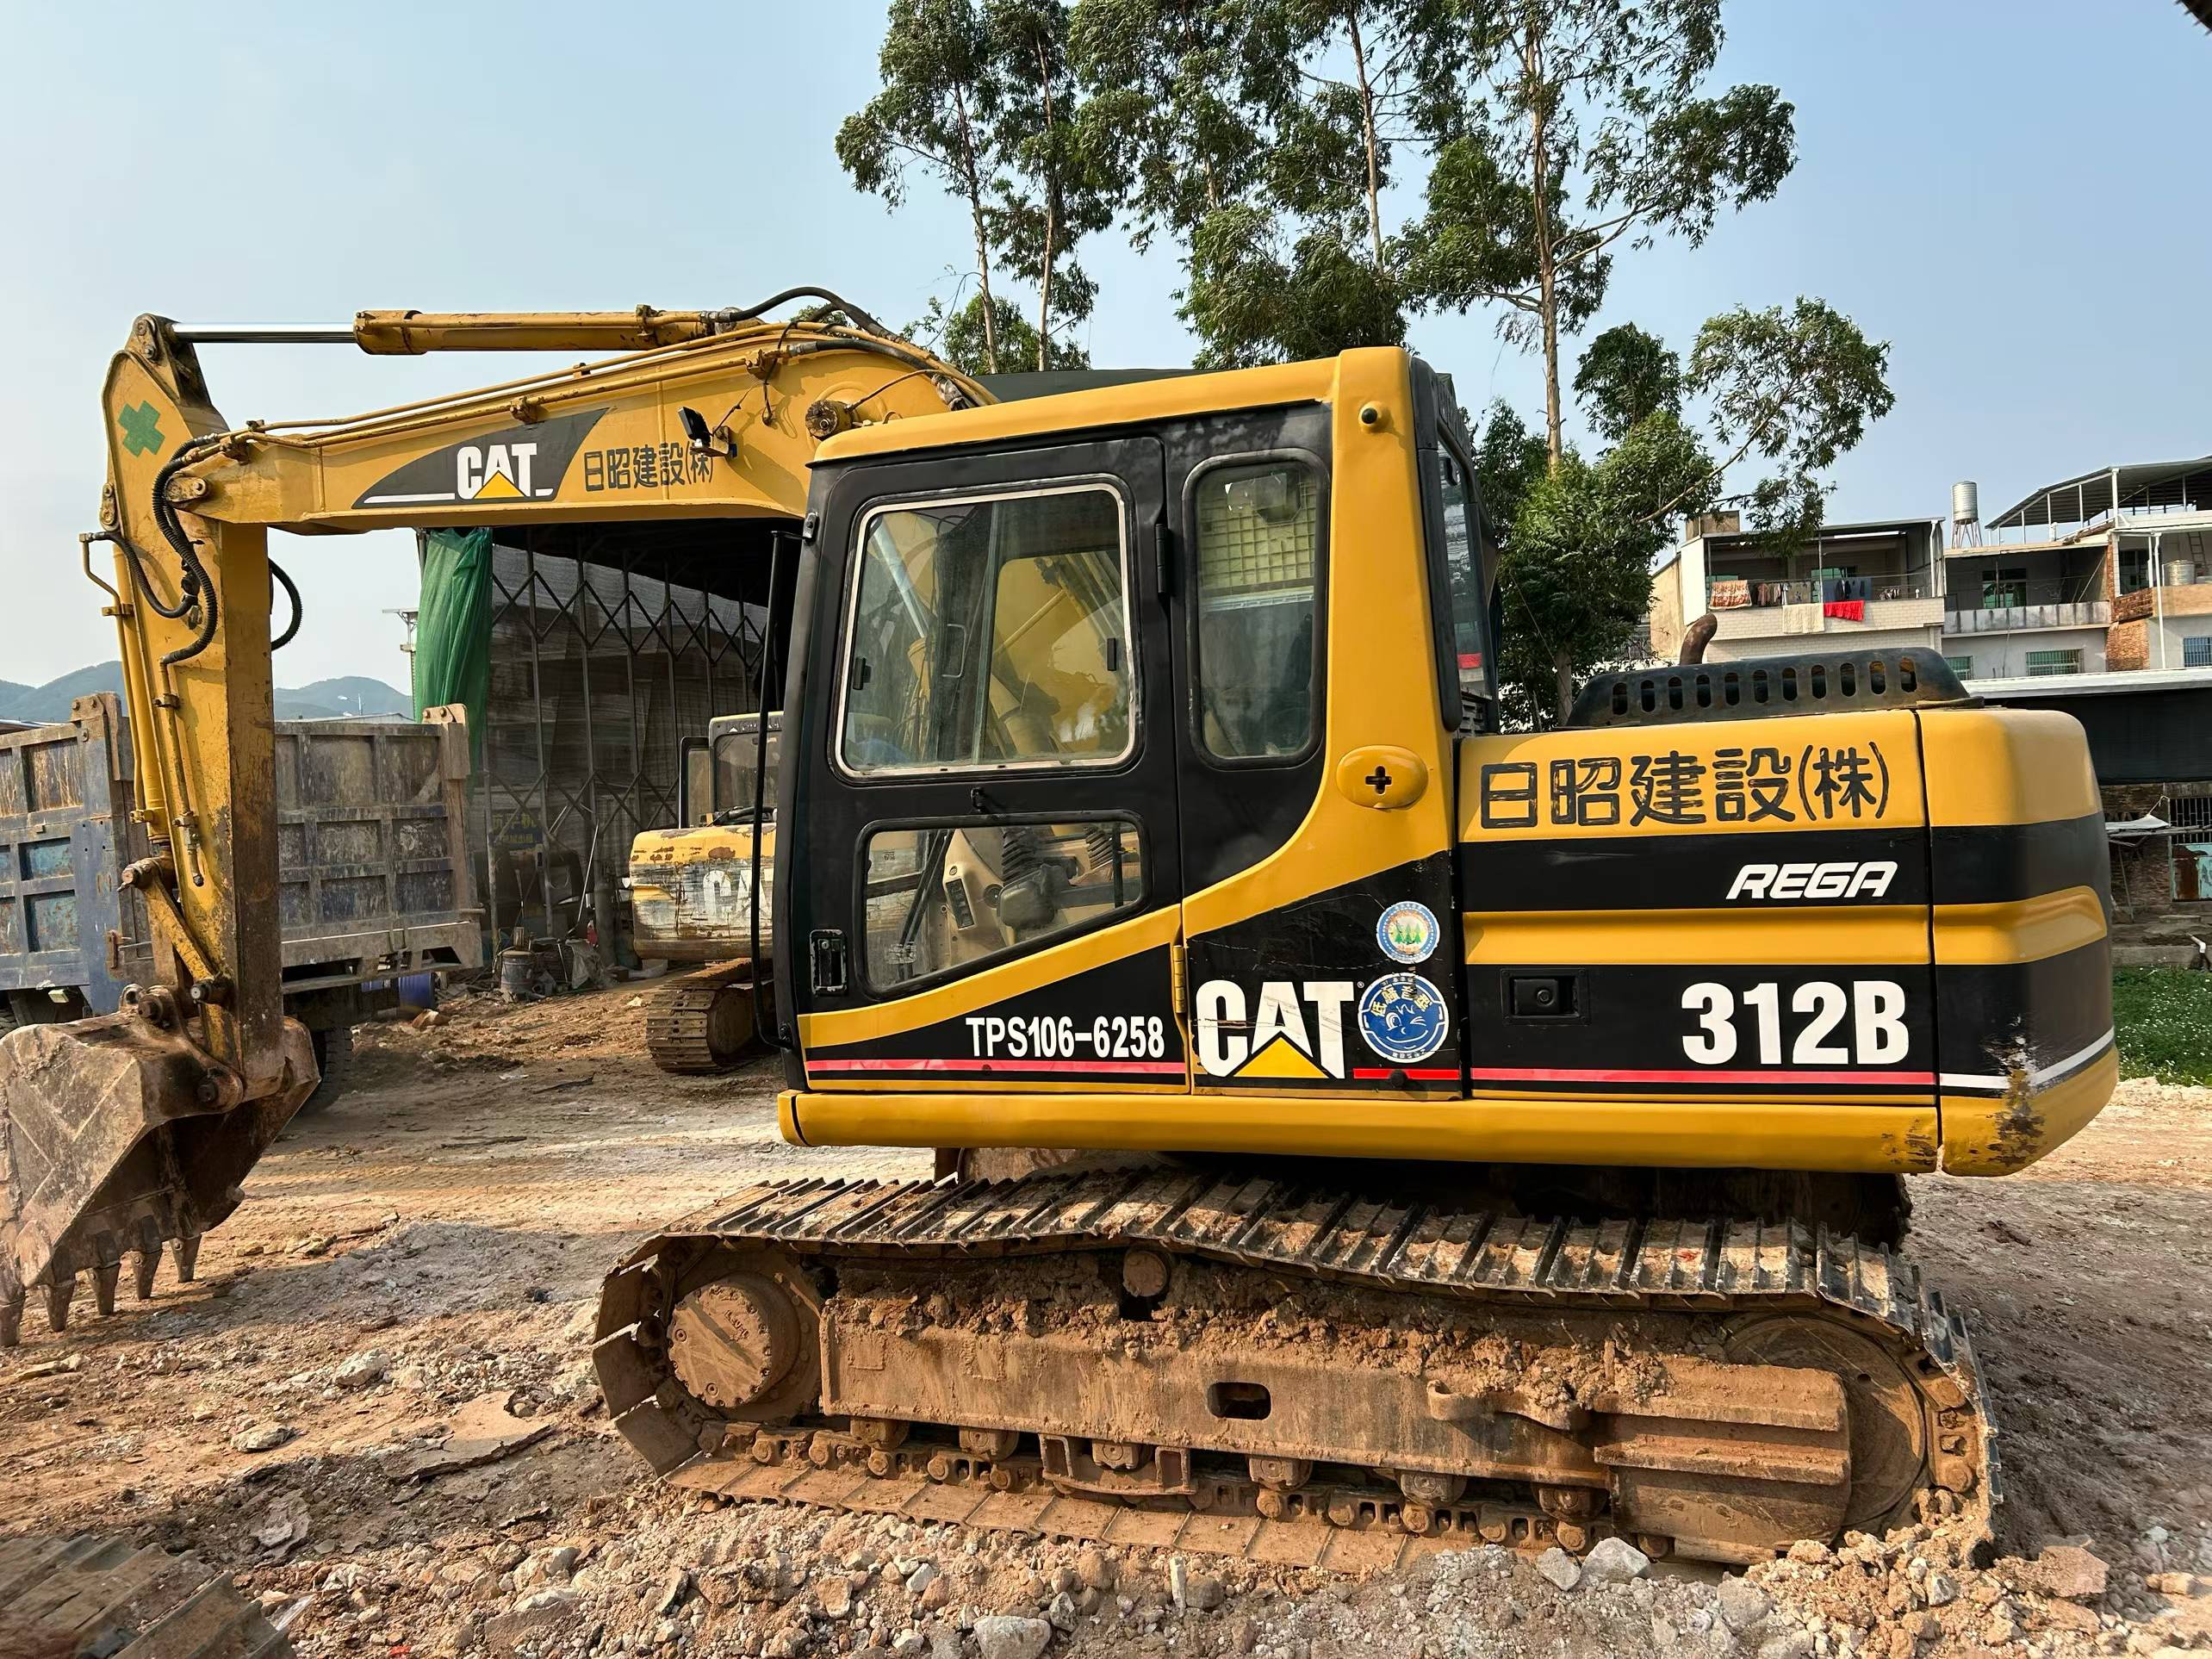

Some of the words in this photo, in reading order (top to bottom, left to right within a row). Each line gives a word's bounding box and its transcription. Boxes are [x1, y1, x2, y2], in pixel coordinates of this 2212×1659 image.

[457, 443, 537, 500] CAT
[1480, 741, 1890, 830] 日昭建設(株)
[703, 868, 774, 918] CA
[1725, 861, 1898, 900] REGA
[965, 1016, 1165, 1059] TPS106-6258
[1196, 979, 1355, 1079] CAT
[1681, 980, 1910, 1065] 312B
